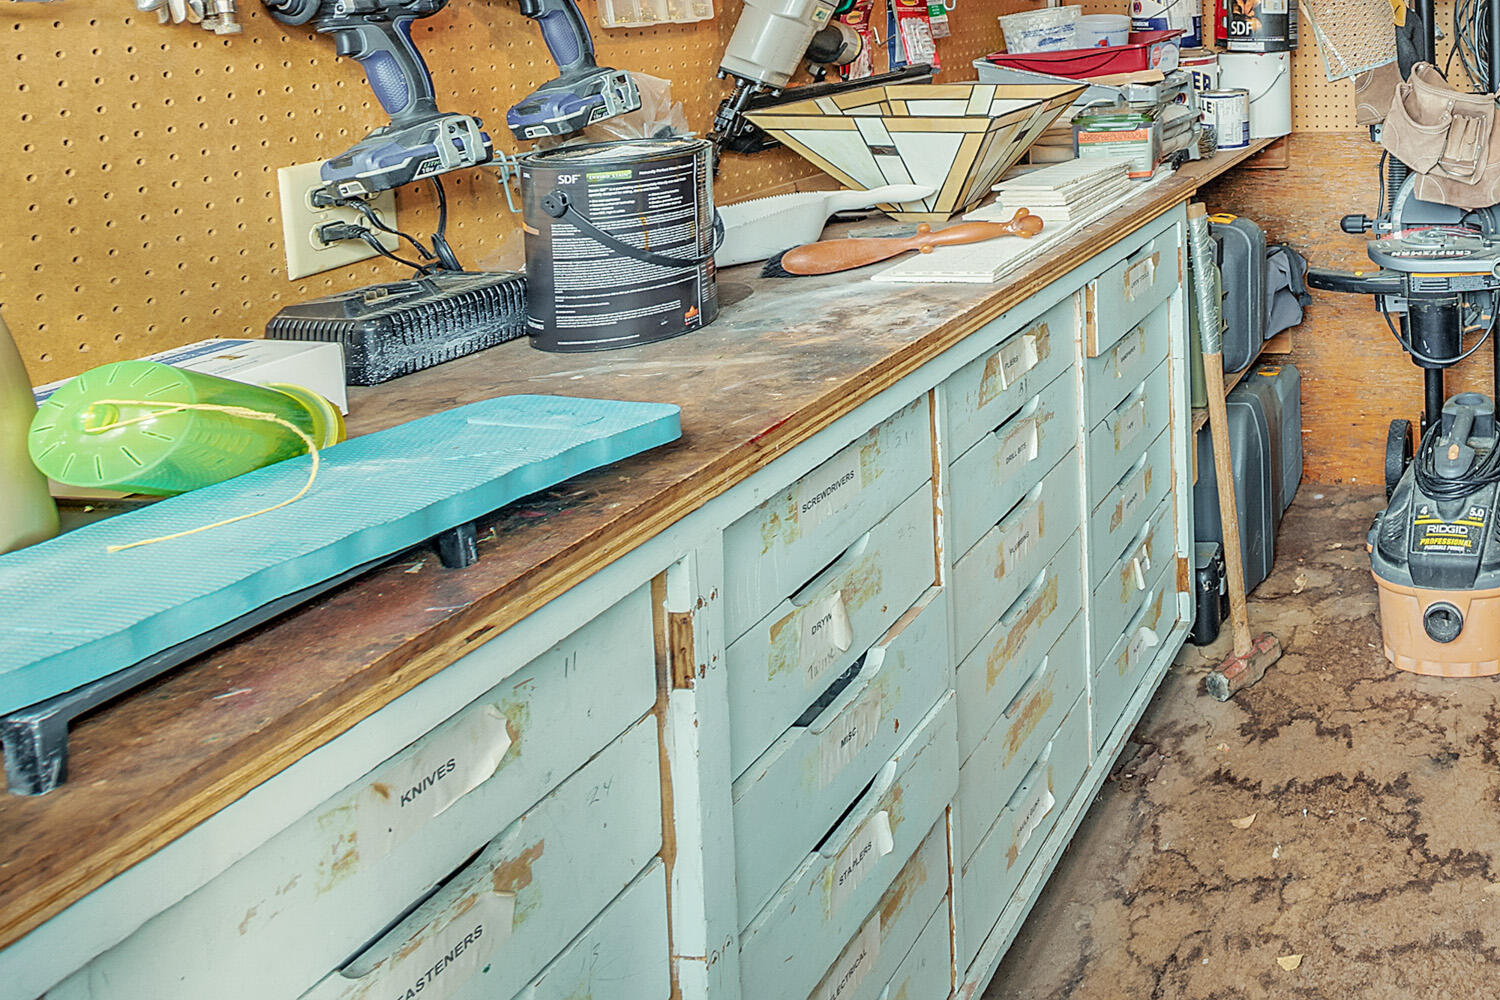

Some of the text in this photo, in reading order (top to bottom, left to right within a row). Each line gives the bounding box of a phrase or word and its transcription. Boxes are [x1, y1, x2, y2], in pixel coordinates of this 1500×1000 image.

[1231, 21, 1254, 36] SDF
[558, 174, 579, 185] SDF
[801, 470, 855, 514] SCREWDRIVERS
[1420, 505, 1485, 518] 4 5.0
[1426, 524, 1469, 535] RIDGID
[1419, 538, 1472, 548] PROFESSIONAL
[811, 612, 832, 636] DRYW
[840, 727, 858, 749] MISC.
[400, 757, 457, 808] KNIVES
[838, 841, 874, 886] STAPLERS
[397, 924, 484, 1000] ASTENERS
[829, 948, 868, 1000] LECTRICAL
